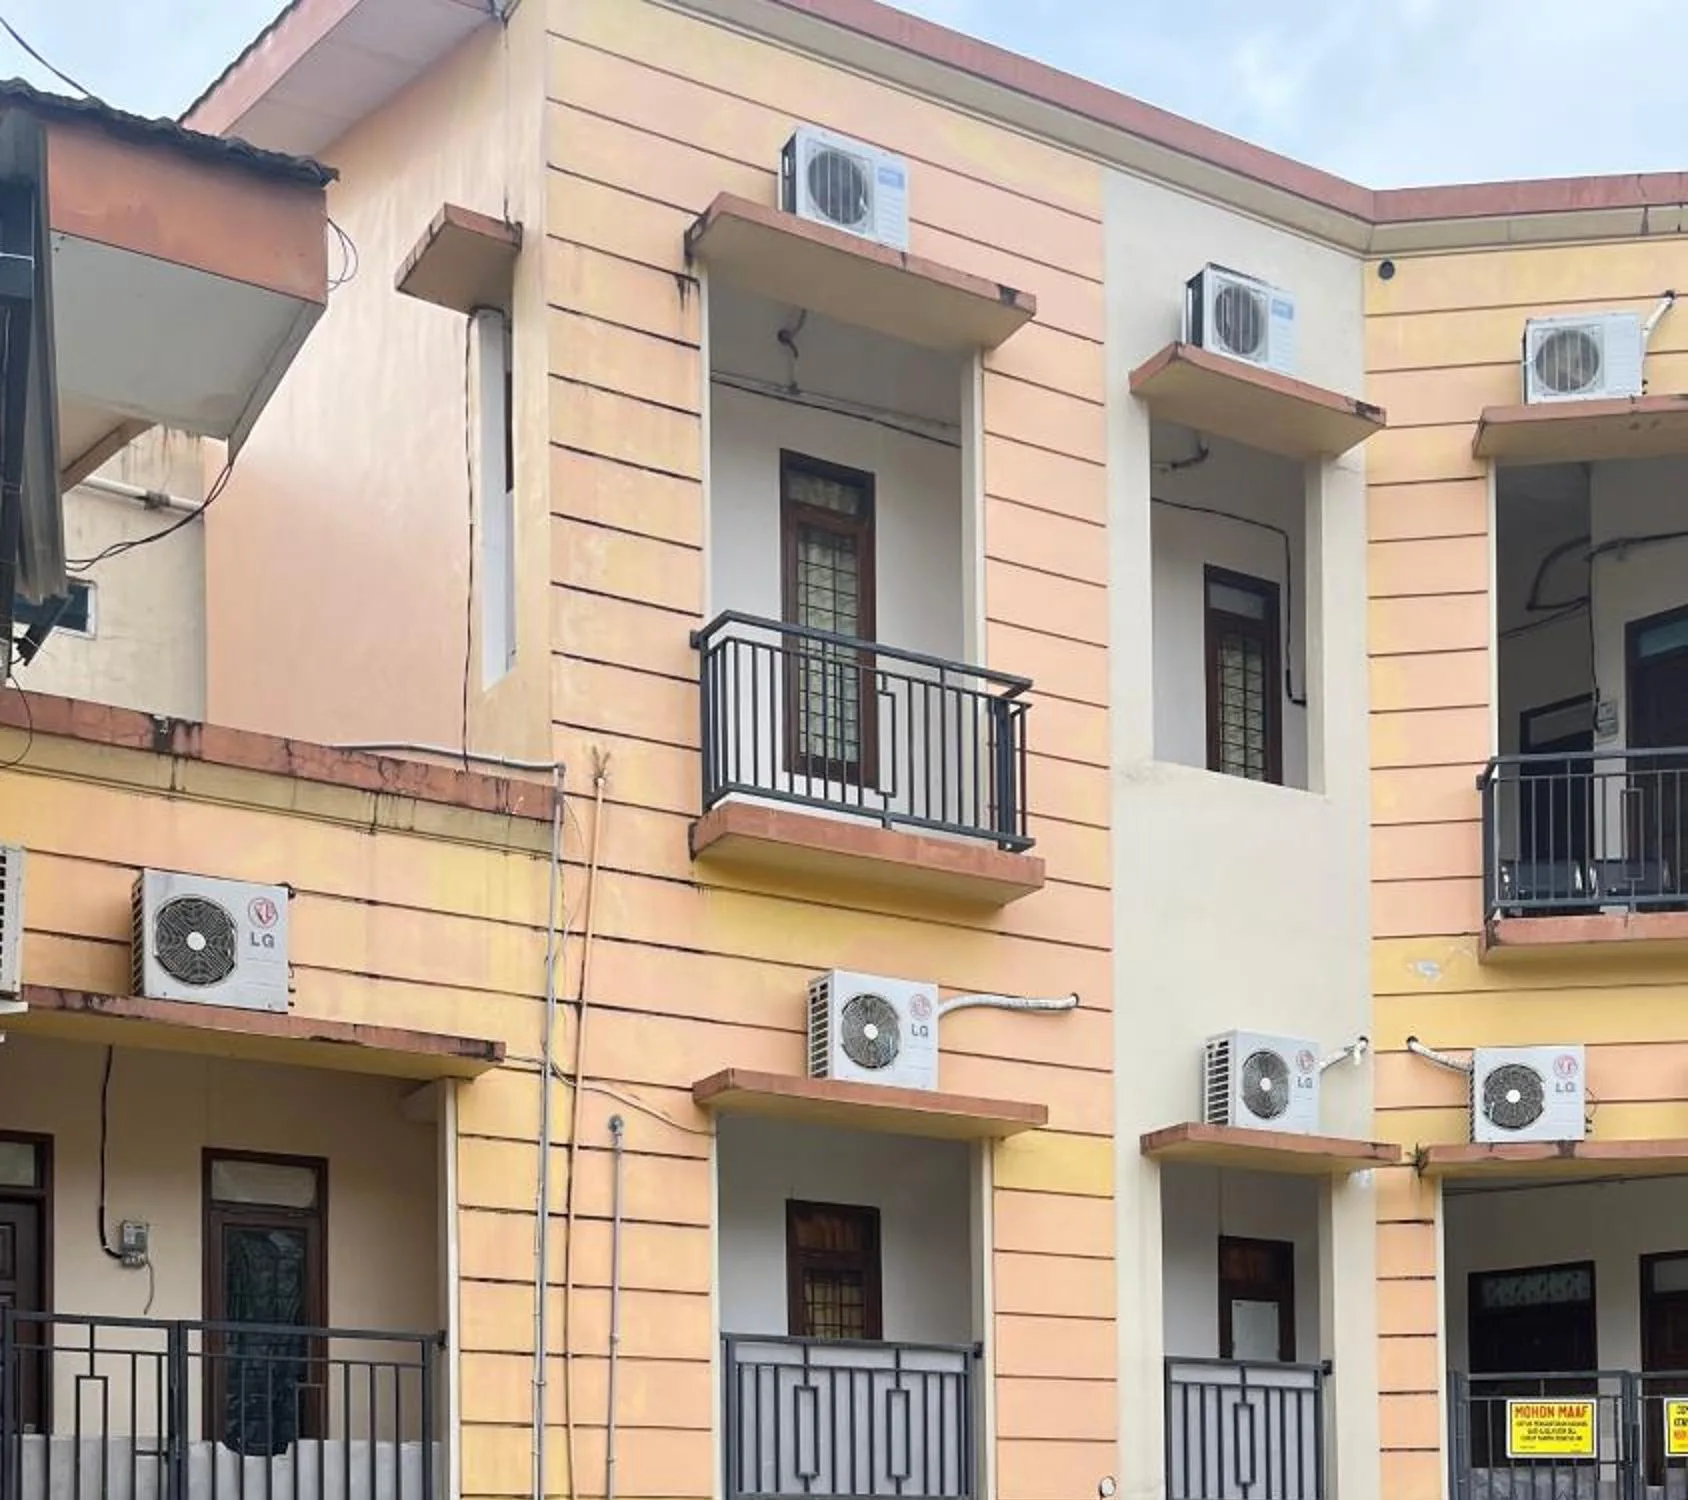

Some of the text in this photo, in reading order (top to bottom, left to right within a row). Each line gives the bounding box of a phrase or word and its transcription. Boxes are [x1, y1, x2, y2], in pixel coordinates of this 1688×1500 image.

[251, 931, 275, 948] LG
[911, 1023, 929, 1037] LG
[1297, 1076, 1313, 1088] LG
[1555, 1082, 1576, 1093] LG
[1514, 1405, 1589, 1418] MOHON MAAF
